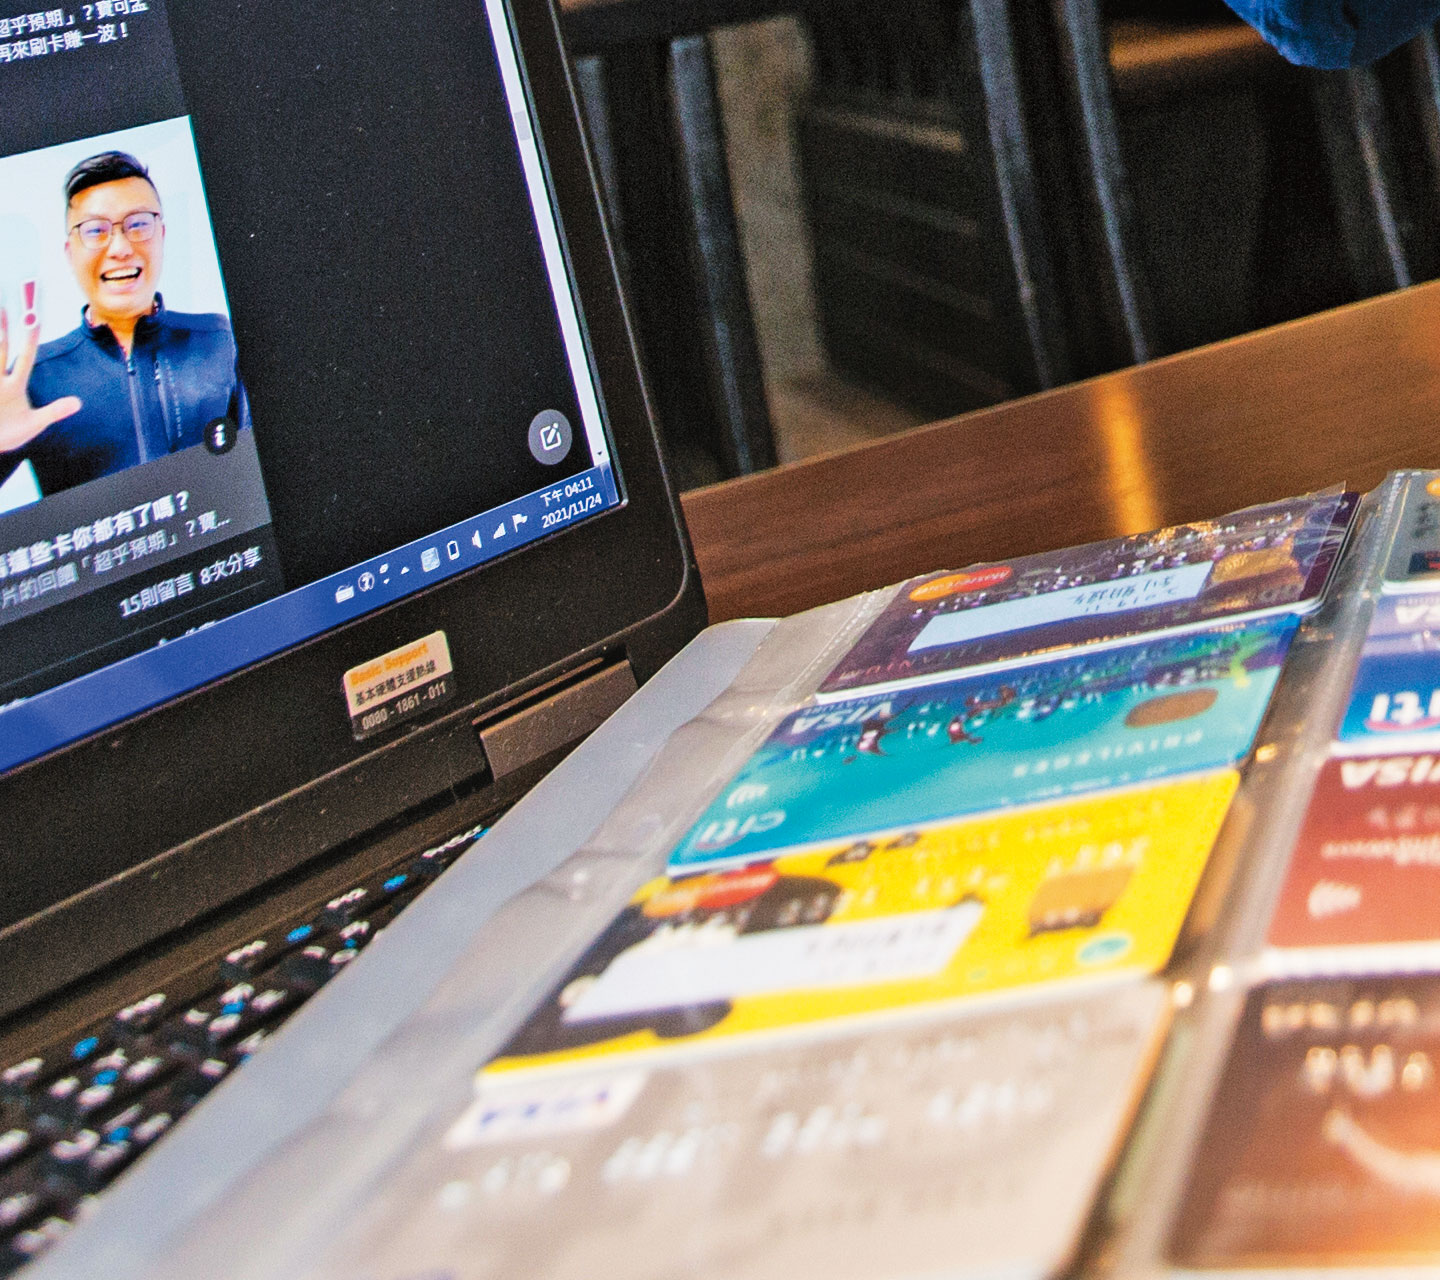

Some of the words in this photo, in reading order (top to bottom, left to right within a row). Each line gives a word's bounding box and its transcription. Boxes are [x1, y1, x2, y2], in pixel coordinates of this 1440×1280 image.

[539, 488, 564, 507] 下午
[564, 476, 594, 498] 04:11
[541, 492, 603, 529] 2021/11/24
[199, 545, 263, 586] 8次分享
[428, 681, 447, 701] 011
[791, 700, 895, 736] VISA
